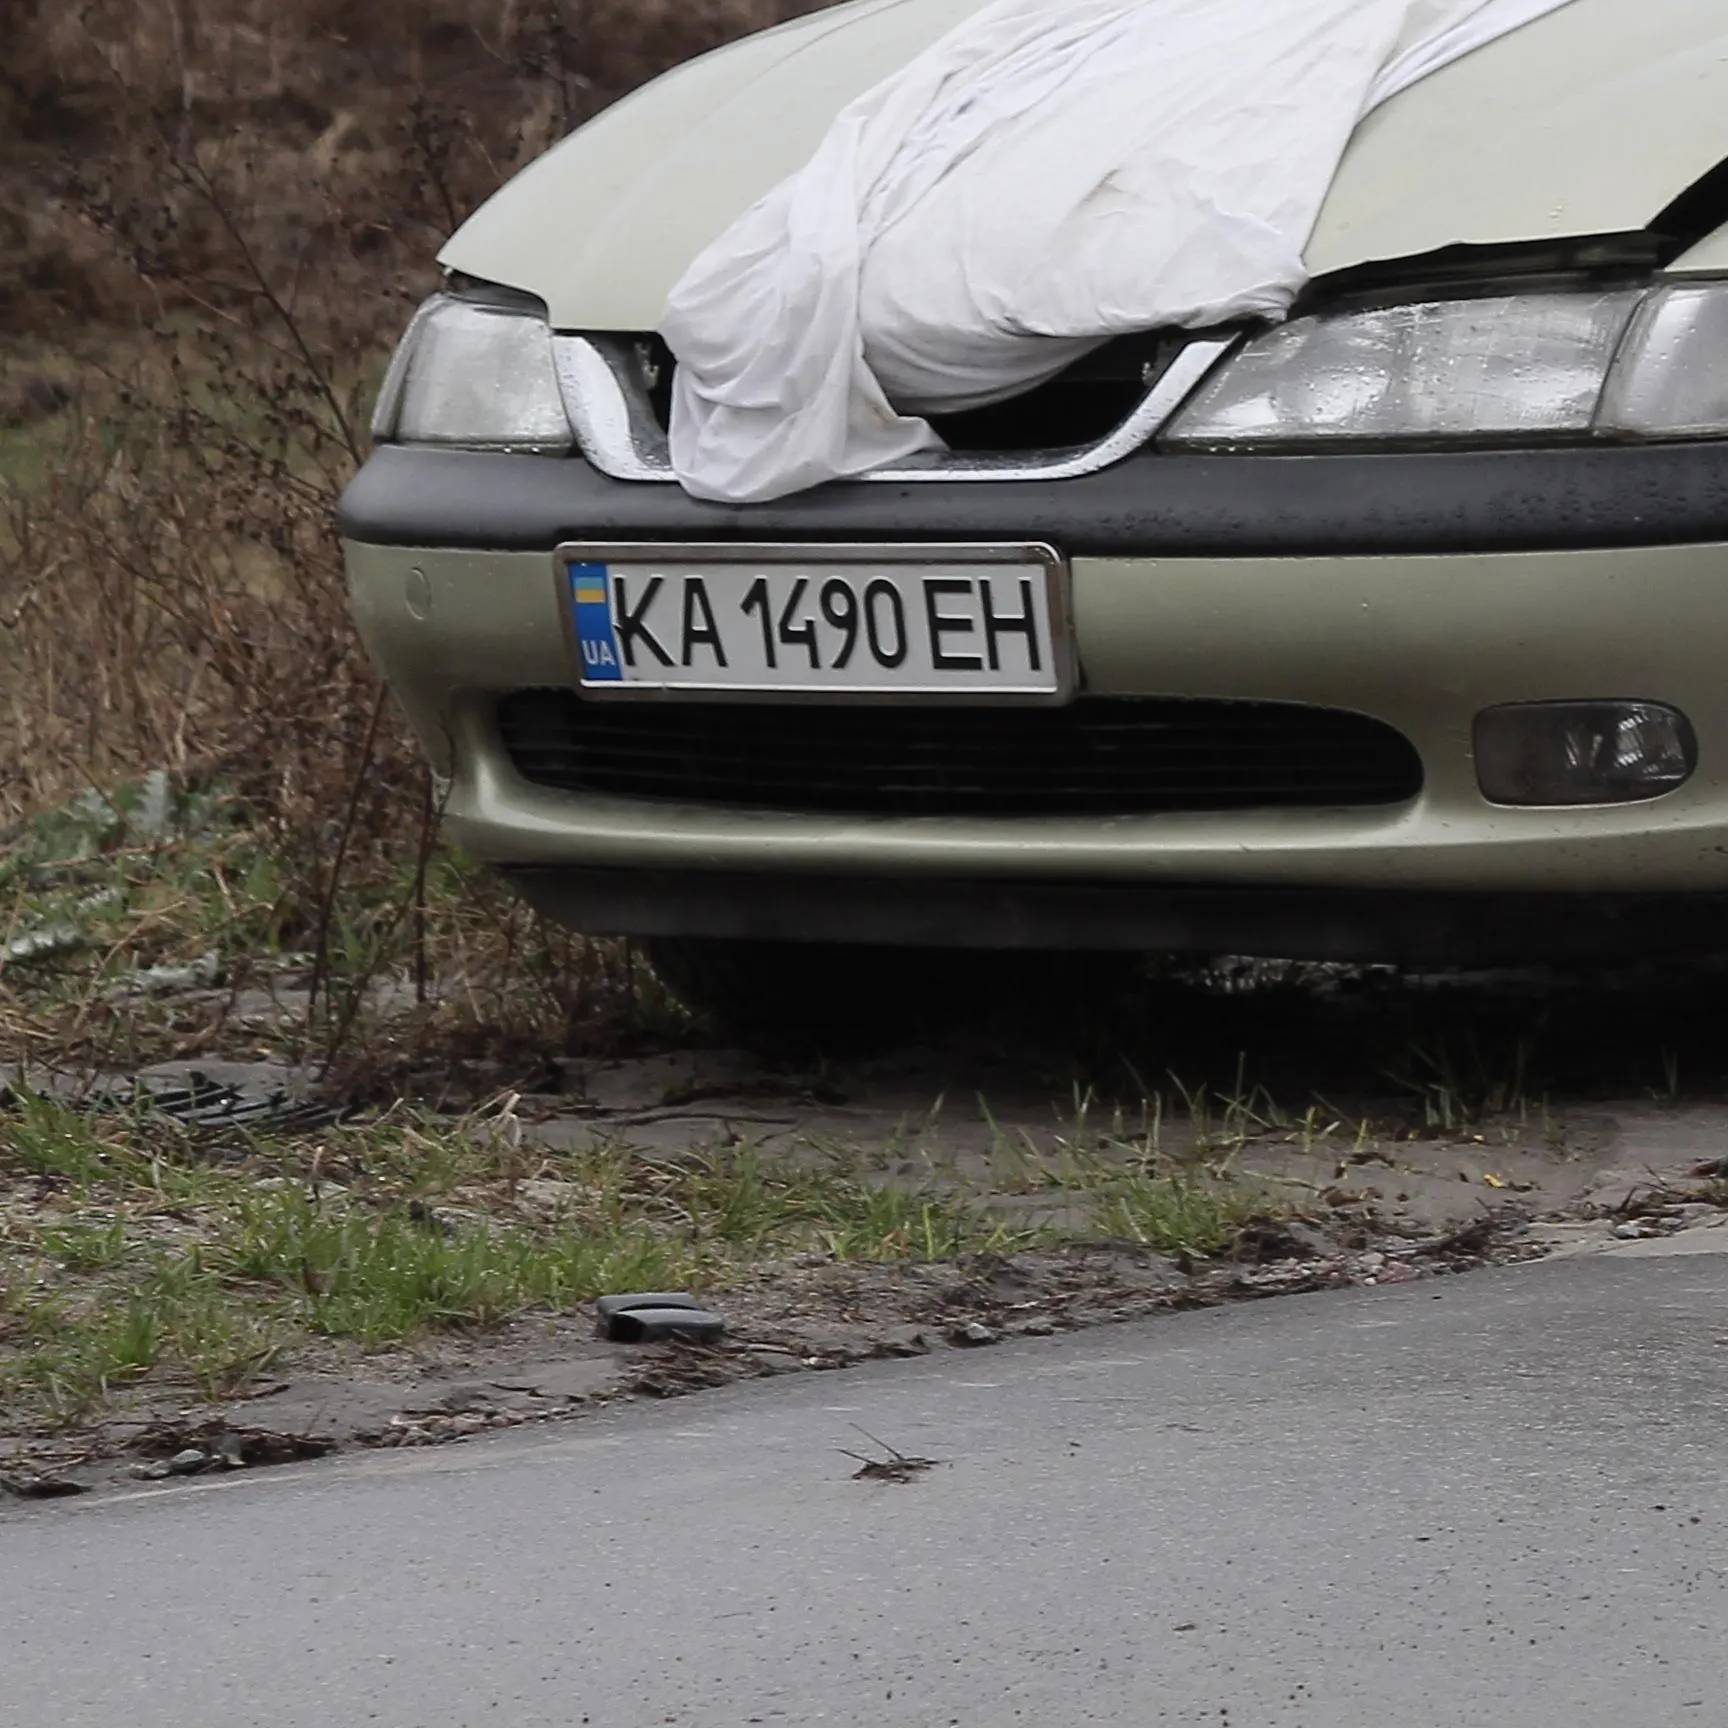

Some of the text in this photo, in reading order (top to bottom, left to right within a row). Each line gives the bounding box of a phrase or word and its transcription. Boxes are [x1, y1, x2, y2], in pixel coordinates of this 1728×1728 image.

[582, 640, 615, 667] UA
[612, 576, 1041, 671] KA 1490 EH
